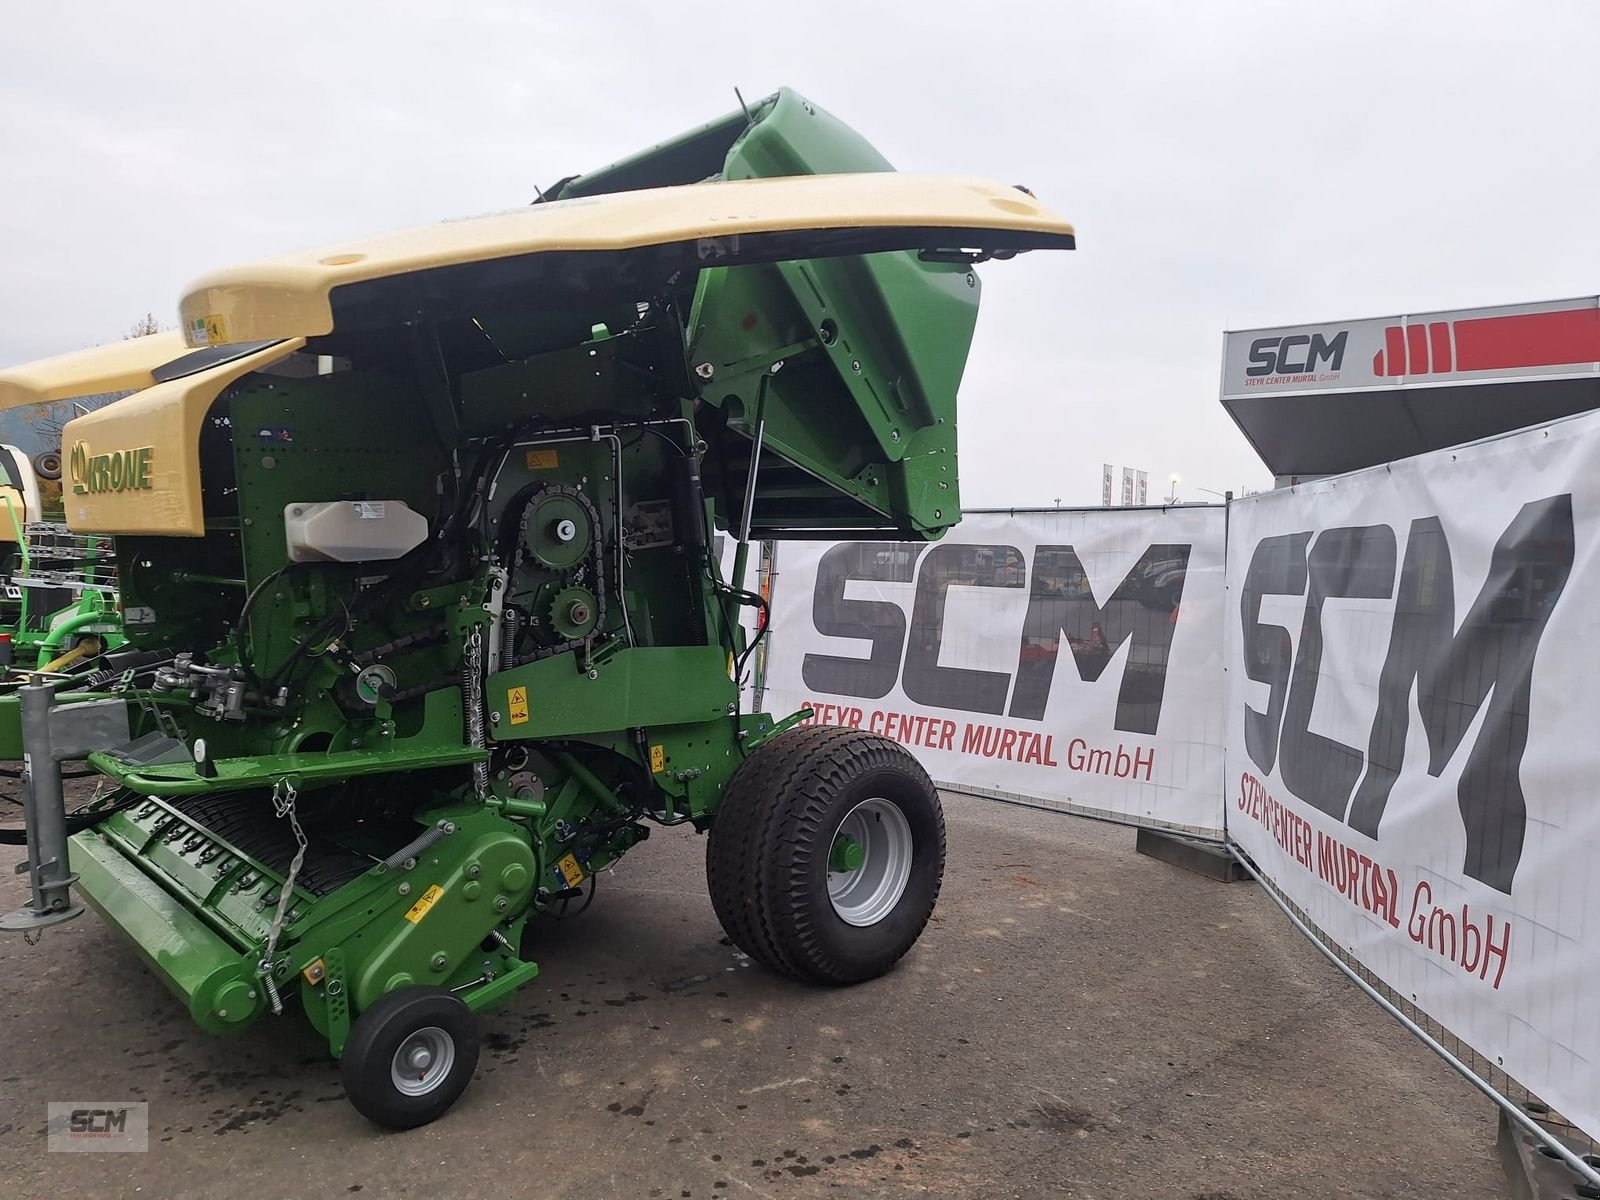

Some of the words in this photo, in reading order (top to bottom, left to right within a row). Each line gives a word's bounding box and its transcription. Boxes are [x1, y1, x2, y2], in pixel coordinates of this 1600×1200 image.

[1245, 378, 1265, 386] STEYR
[1265, 376, 1291, 385] CENTER
[1291, 374, 1317, 383] MURTAL
[1246, 331, 1348, 376] SCM
[87, 446, 153, 493] KRONE
[802, 542, 1192, 736] SCM
[1240, 493, 1575, 895] SCM
[869, 711, 957, 750] CENTER
[961, 723, 1057, 767] MURTAL
[1067, 738, 1154, 781] GmbH
[1317, 831, 1400, 929] MURTAL
[1408, 881, 1511, 990] GmbH
